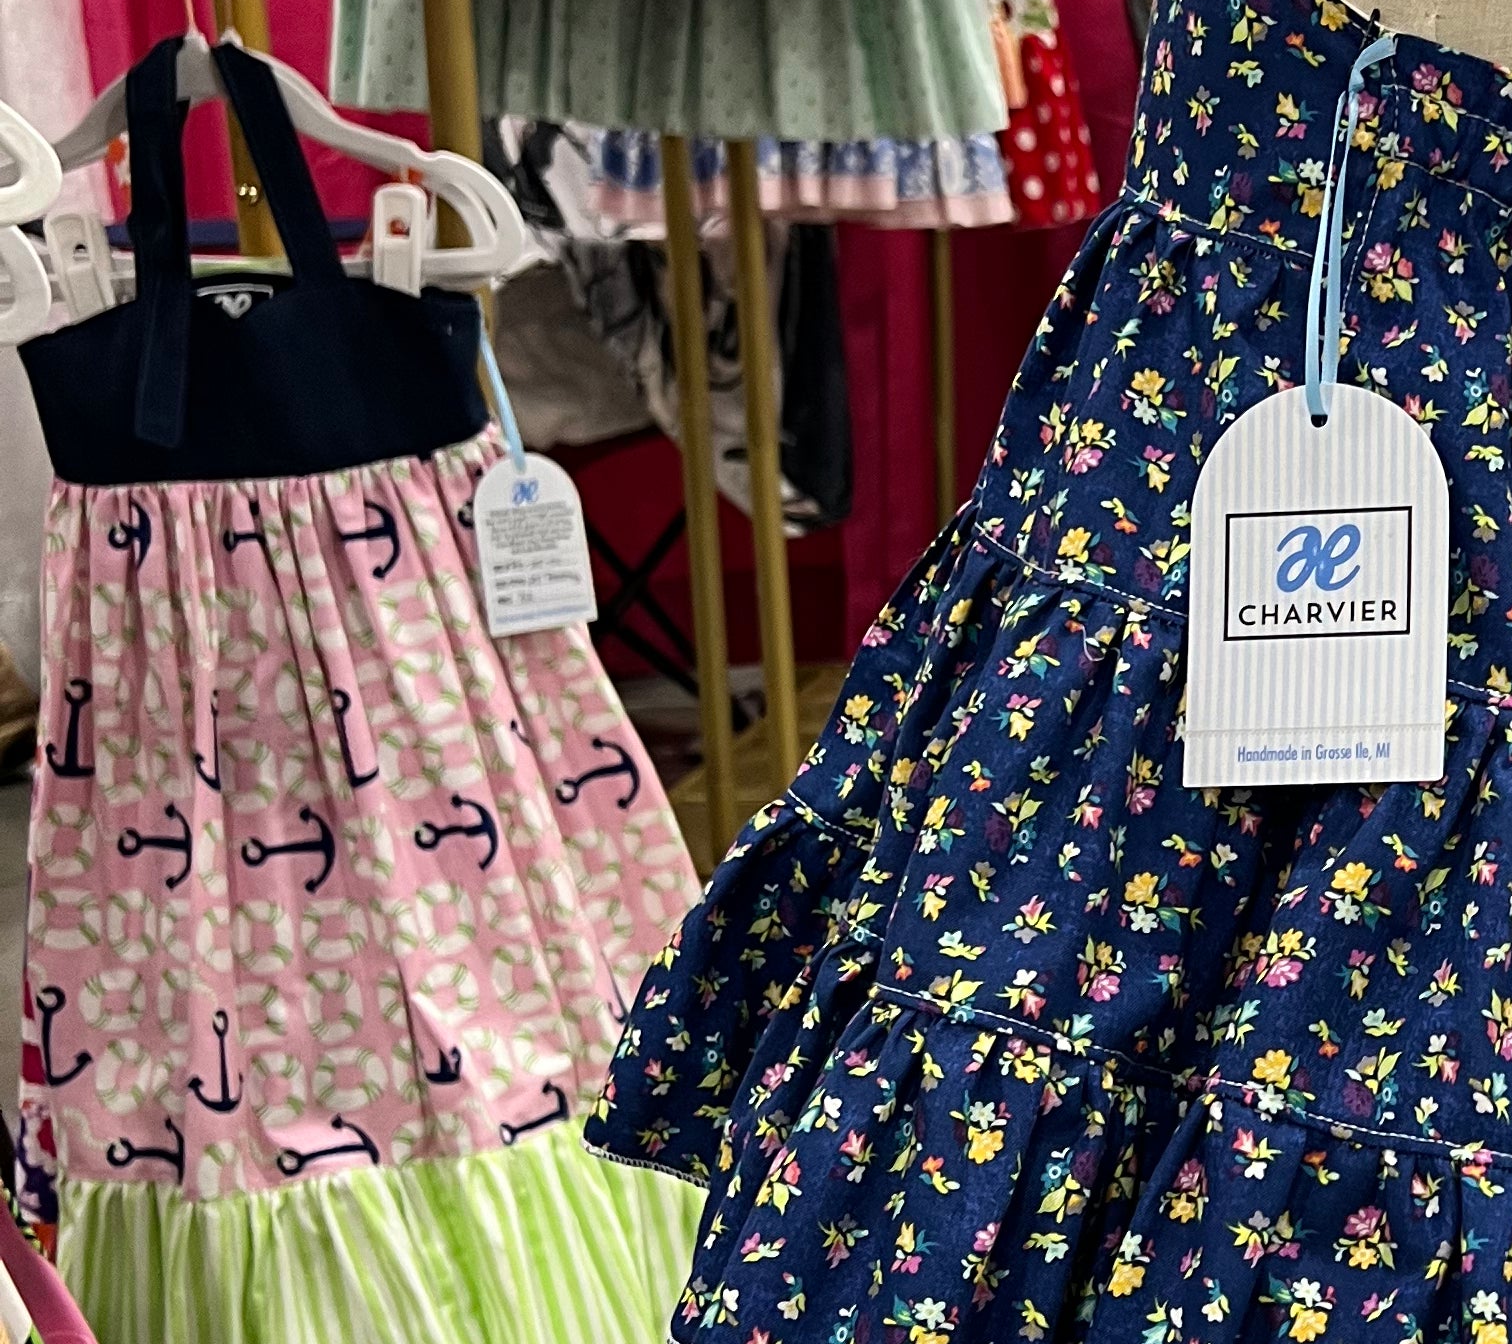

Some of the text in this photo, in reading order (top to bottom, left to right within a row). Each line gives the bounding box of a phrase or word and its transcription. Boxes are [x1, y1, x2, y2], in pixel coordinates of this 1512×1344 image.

[1238, 599, 1397, 626] CHARVIER
[1237, 744, 1298, 763] Handmade
[1301, 745, 1312, 761] in
[1315, 743, 1352, 761] Grosse
[1375, 742, 1391, 759] MI
